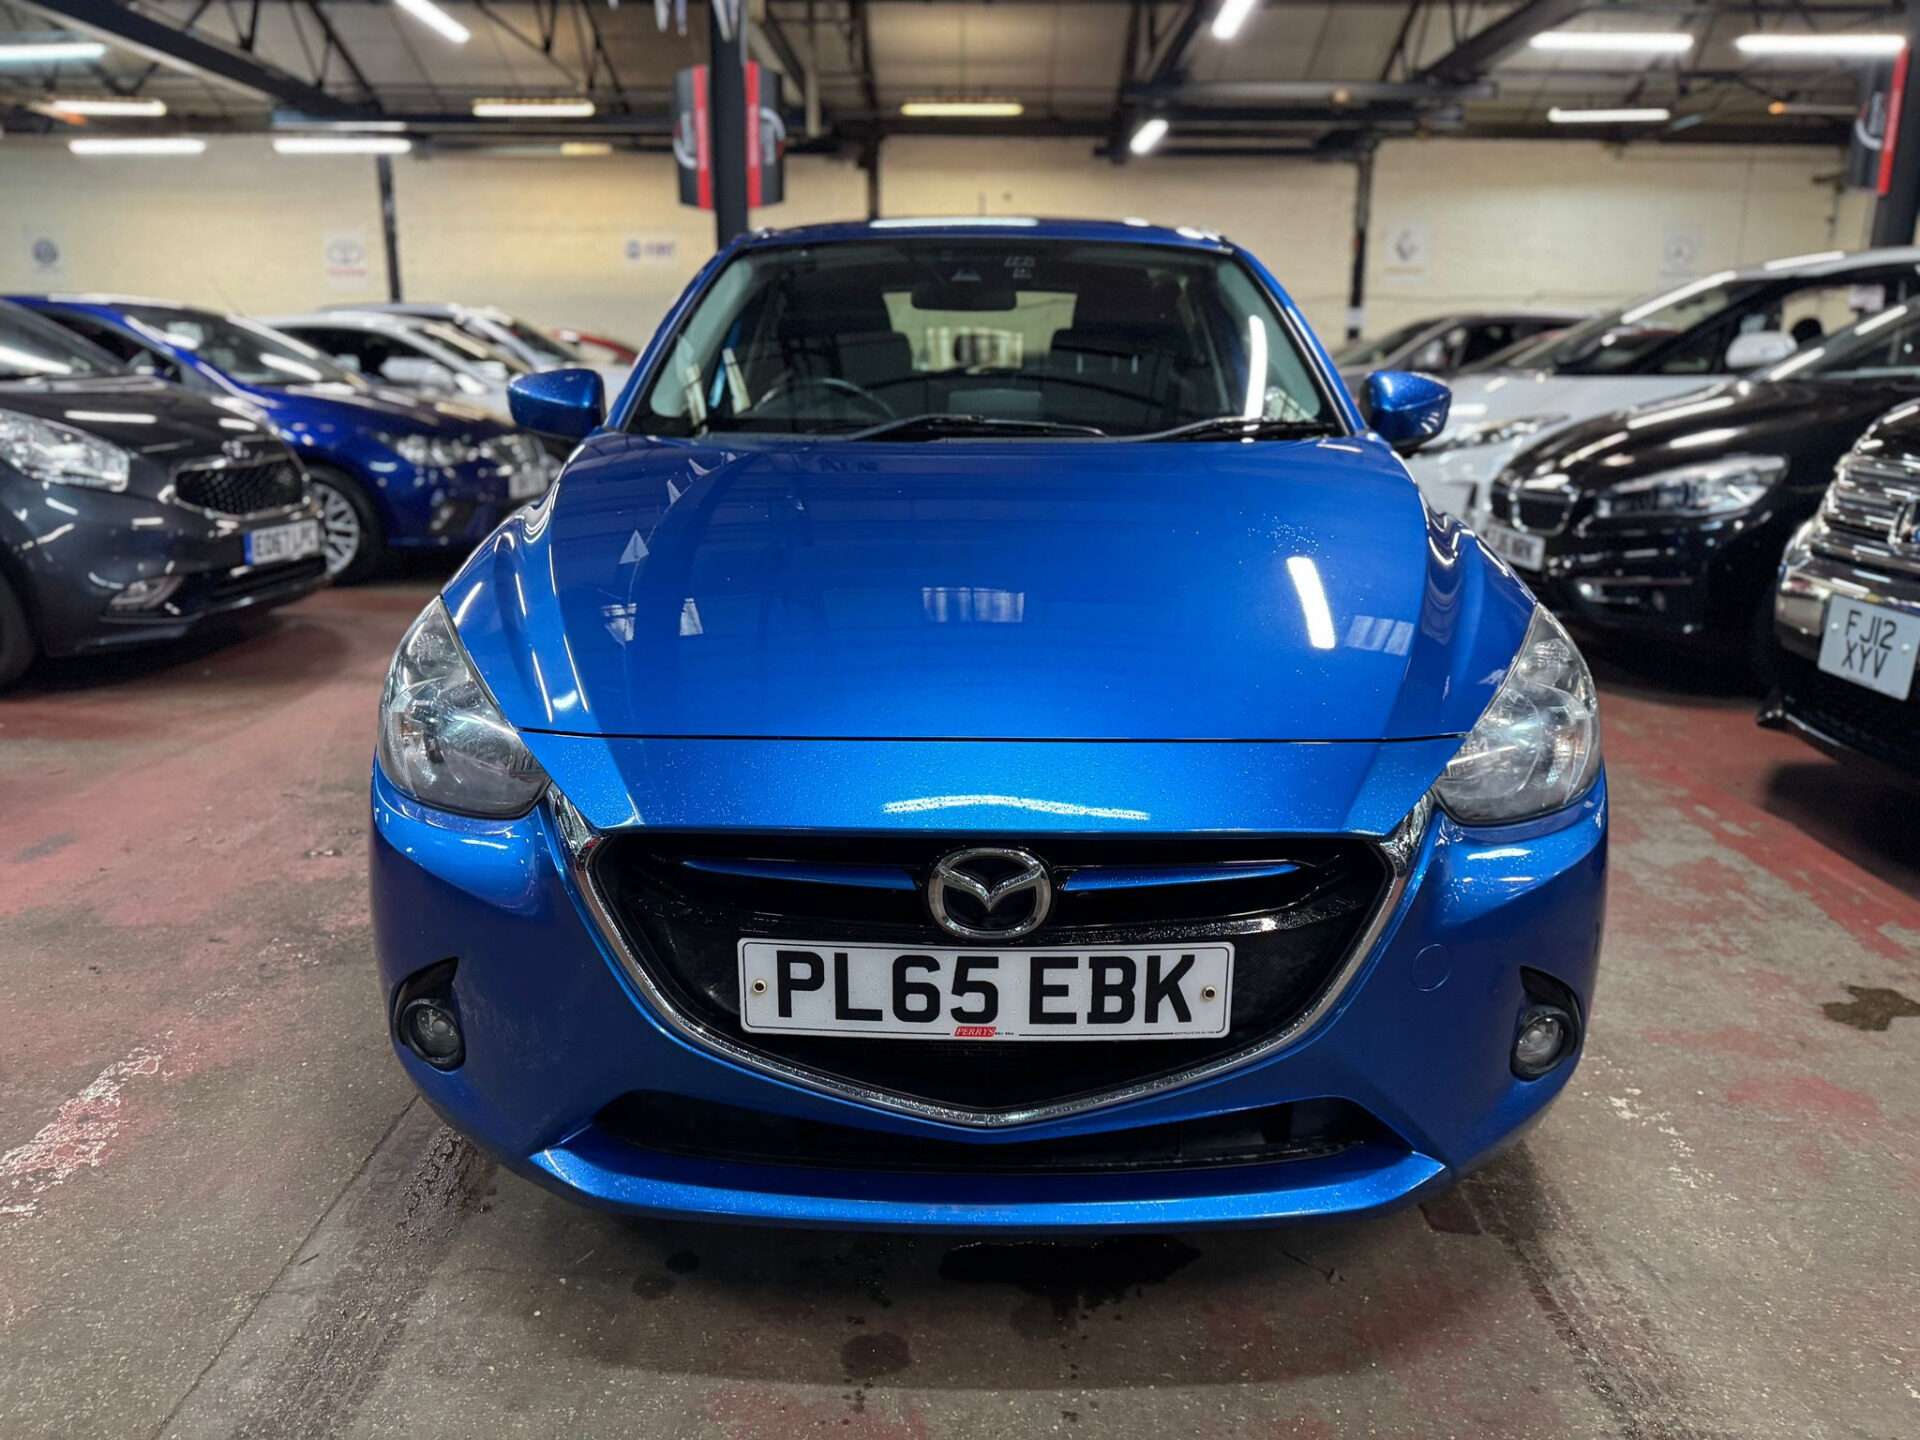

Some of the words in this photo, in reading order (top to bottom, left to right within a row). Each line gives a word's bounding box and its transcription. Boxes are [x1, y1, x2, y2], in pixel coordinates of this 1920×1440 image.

[1845, 609, 1897, 651] FJ12
[1841, 640, 1889, 679] XYV
[776, 950, 999, 1024] PL65
[1028, 953, 1195, 1025] EBK
[956, 1027, 995, 1037] PERRYS
